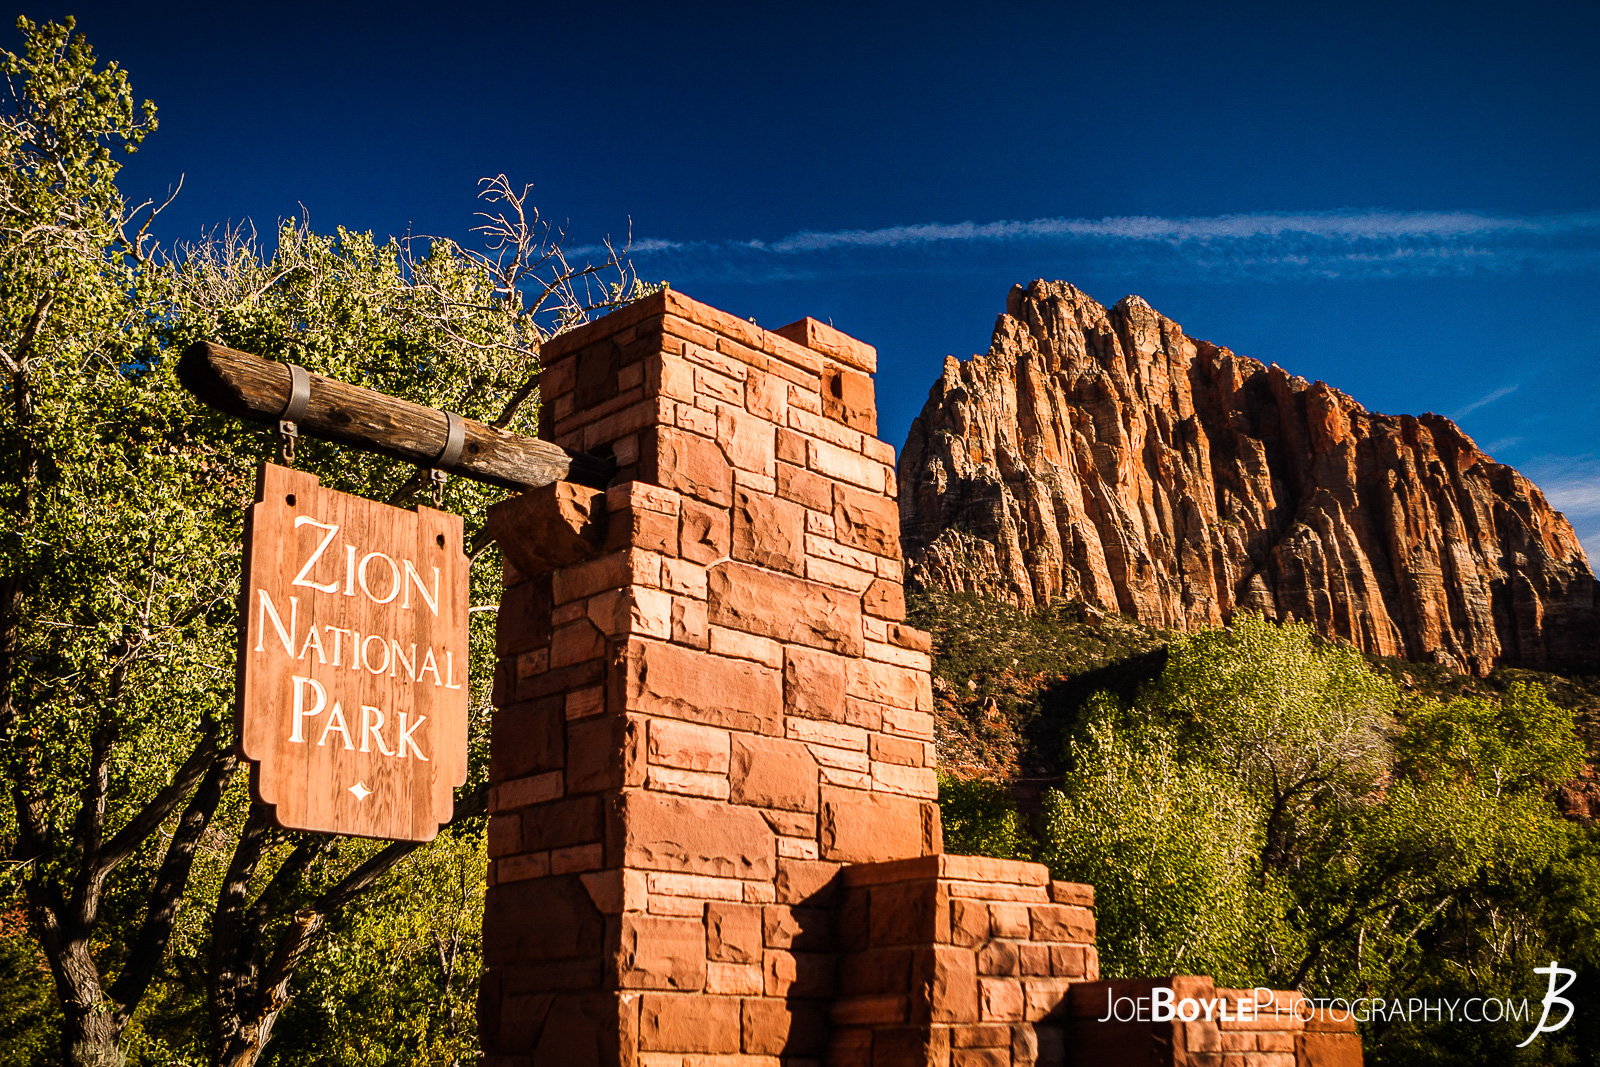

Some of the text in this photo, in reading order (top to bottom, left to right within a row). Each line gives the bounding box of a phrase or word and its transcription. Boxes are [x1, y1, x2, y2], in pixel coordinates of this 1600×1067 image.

[291, 515, 441, 617] ZION
[254, 589, 462, 690] NATIONAL
[288, 675, 430, 762] PARK
